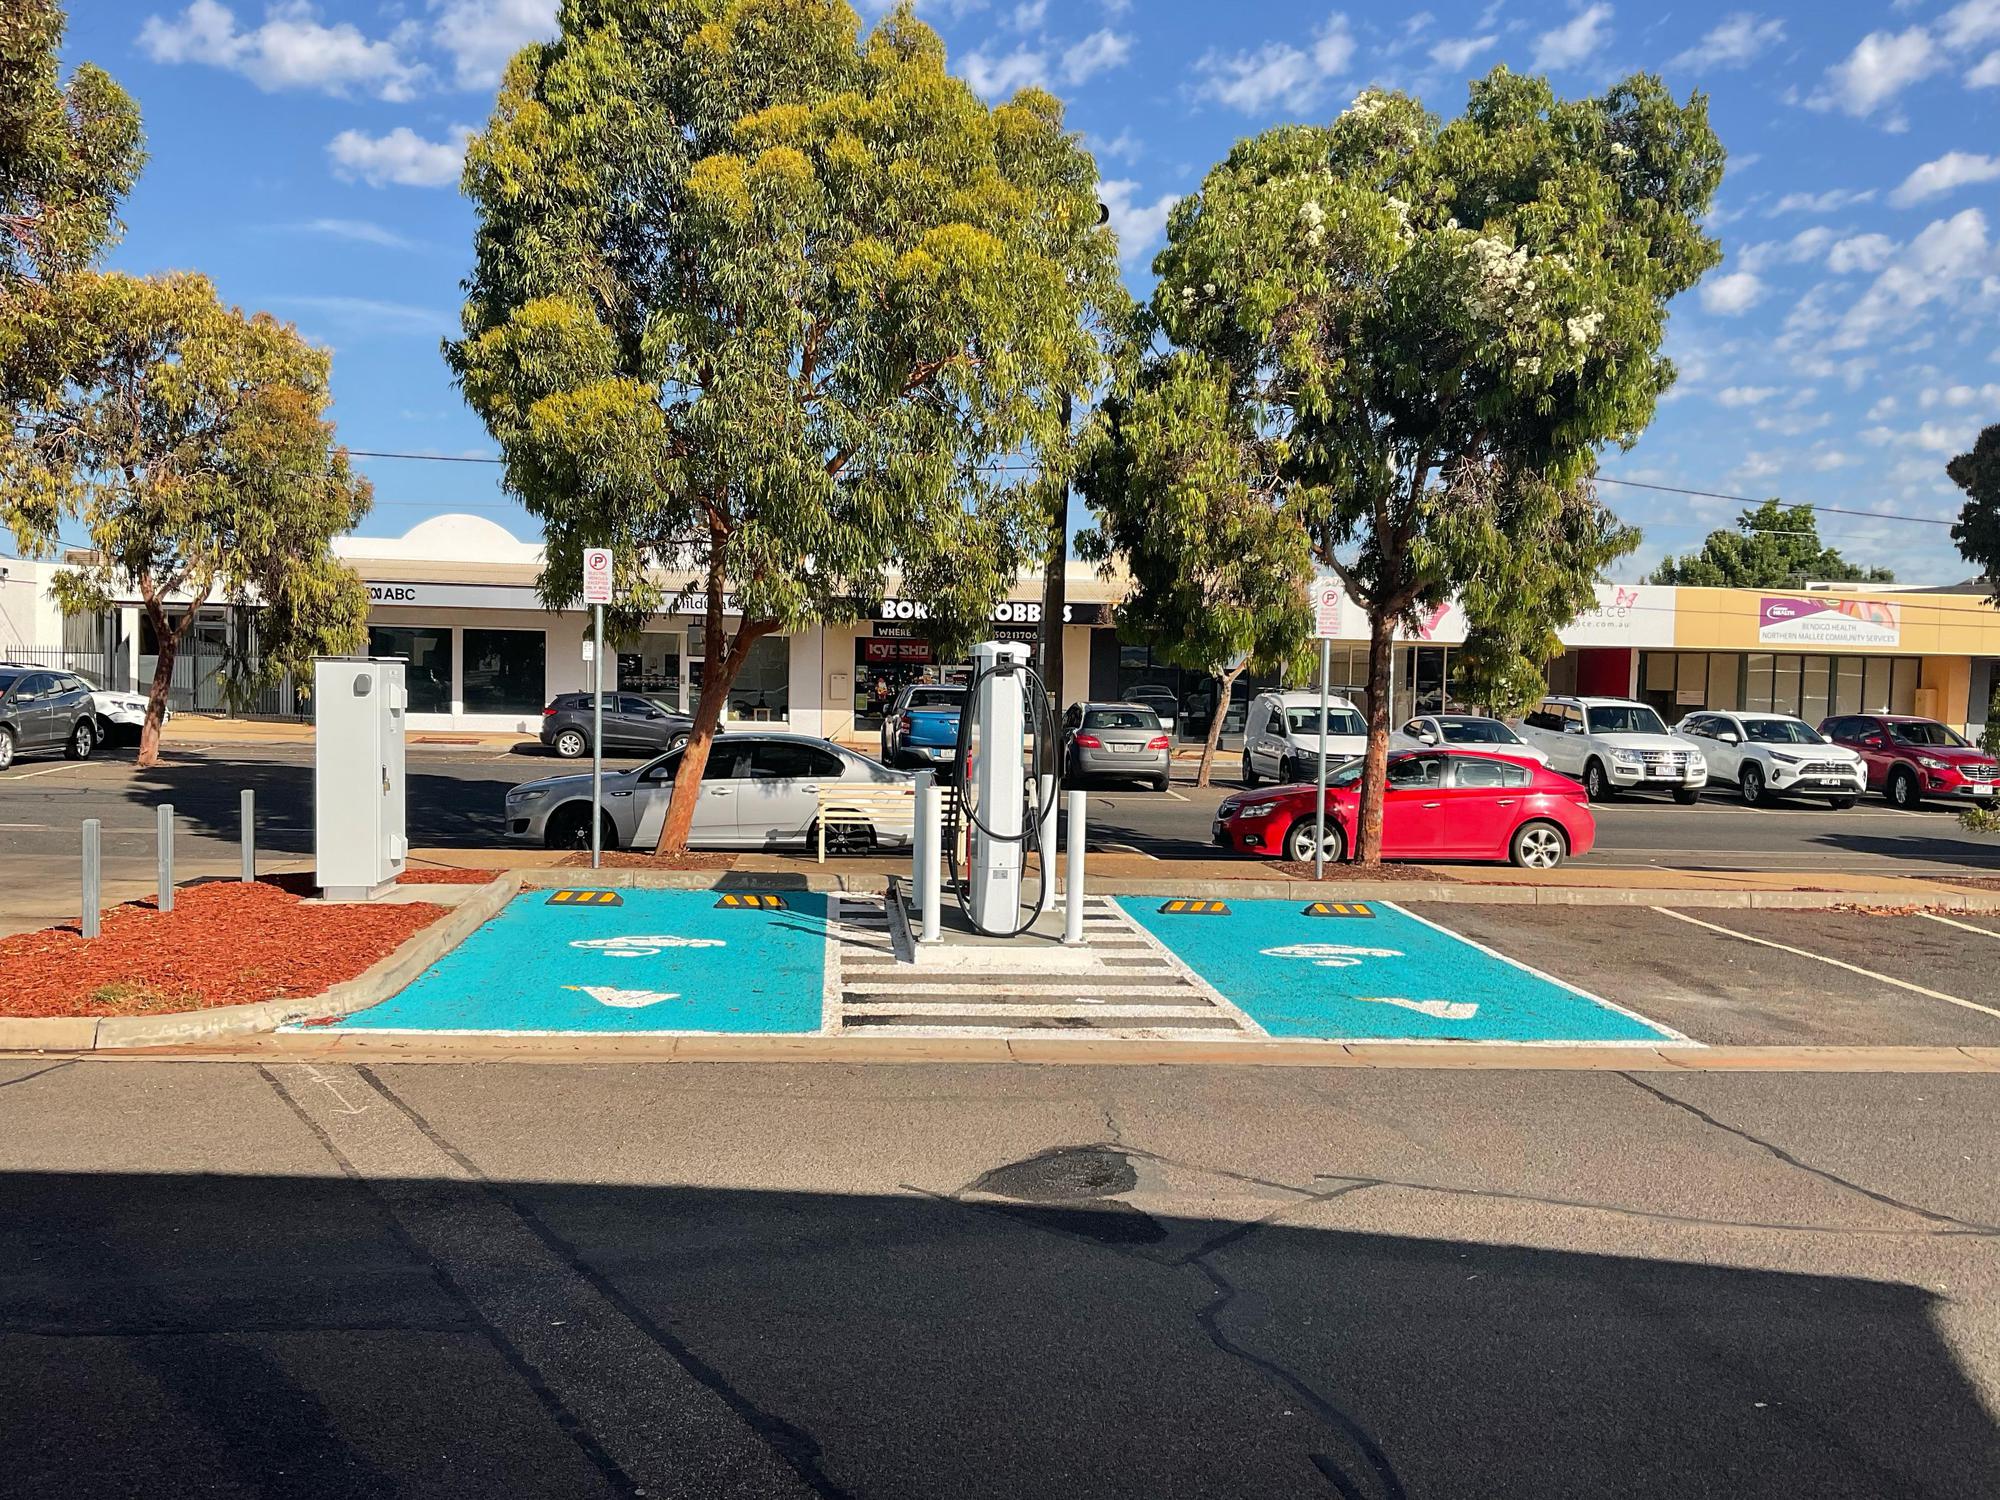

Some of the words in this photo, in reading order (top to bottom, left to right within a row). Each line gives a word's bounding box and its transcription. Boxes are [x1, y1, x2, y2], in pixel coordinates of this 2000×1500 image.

[383, 587, 416, 601] ABC
[985, 603, 1072, 622] OBBS
[879, 627, 912, 637] WHERE
[1802, 622, 1831, 631] BENDIGO
[1832, 623, 1857, 631] HEALTH
[1762, 631, 1797, 640] NORTHERN
[1798, 632, 1824, 640] MALLEE
[1825, 633, 1865, 641] COMMUNITY
[1866, 634, 1895, 643] SERVICES
